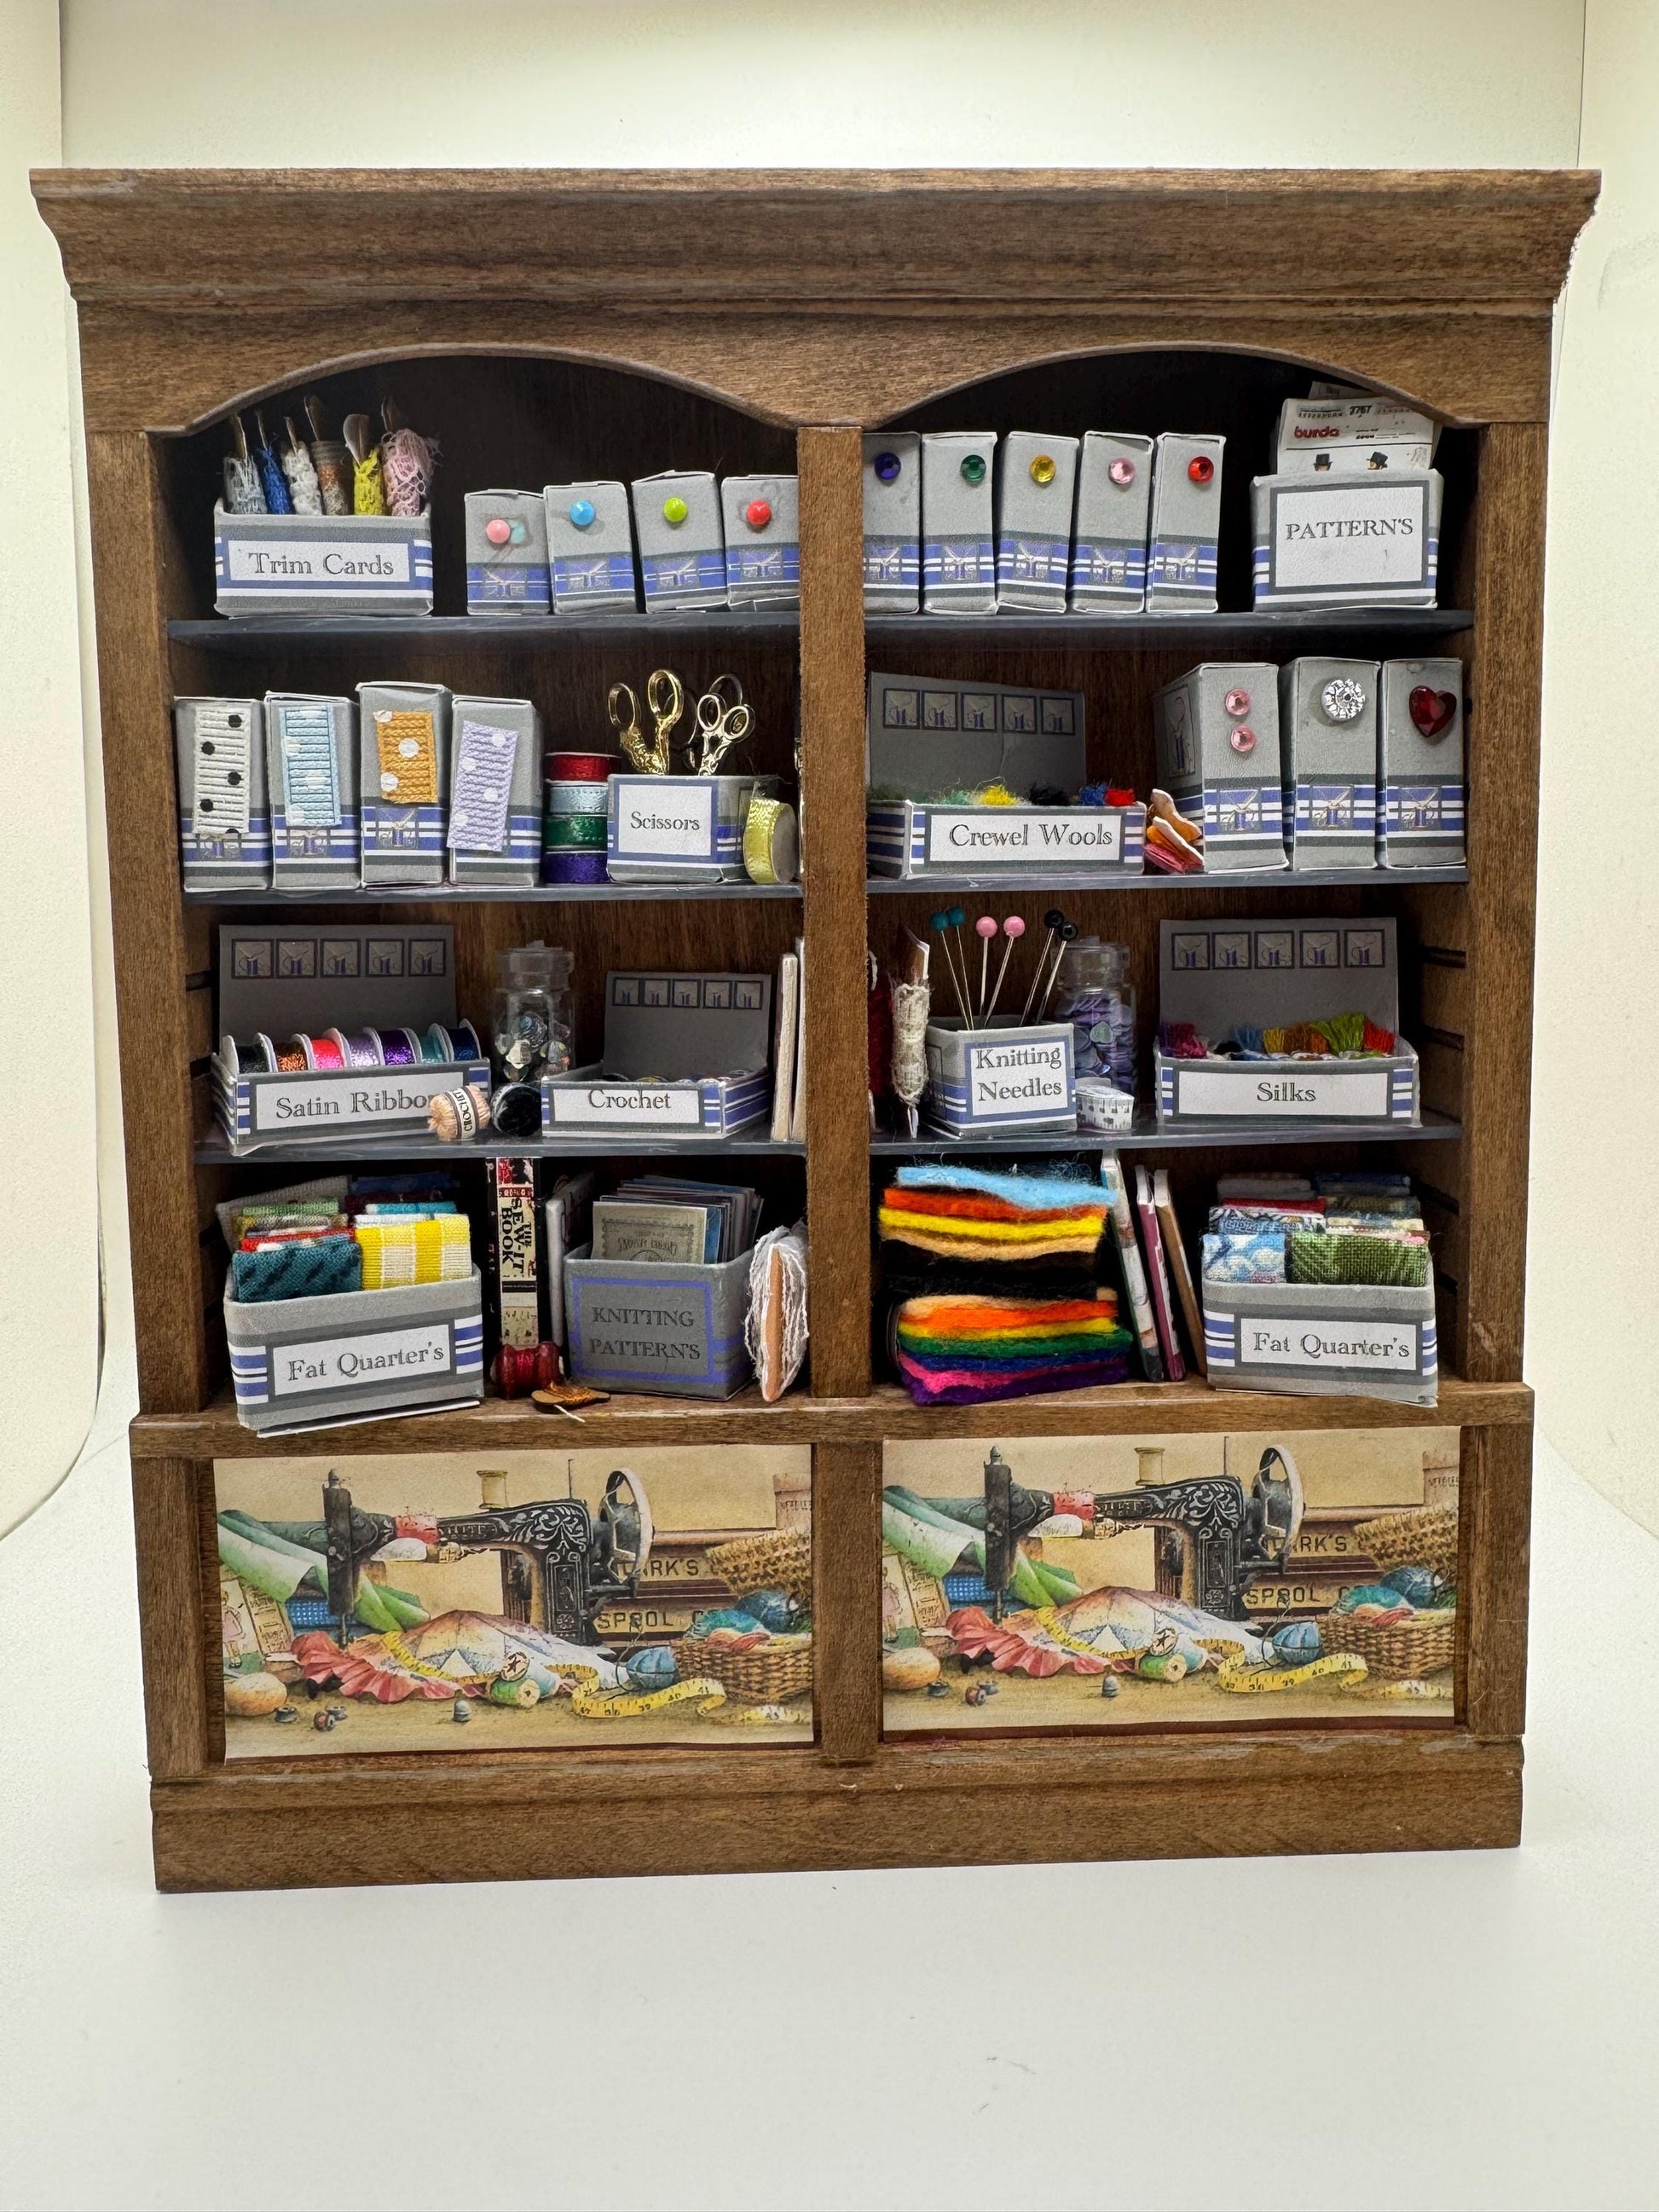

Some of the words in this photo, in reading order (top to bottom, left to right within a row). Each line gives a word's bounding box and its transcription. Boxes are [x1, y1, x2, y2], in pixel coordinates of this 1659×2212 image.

[1294, 426, 1340, 439] burda
[1285, 518, 1413, 540] PATTERN'S
[248, 552, 313, 575] Trim
[323, 553, 394, 575] Cards
[630, 811, 700, 830] Scissors
[949, 823, 1029, 846] Crewel
[1039, 823, 1113, 846] Wools
[975, 1048, 1062, 1070] Knitting
[588, 1089, 672, 1110] Crochet
[978, 1077, 1062, 1102] Needles
[1257, 1082, 1316, 1102] Silks
[275, 1097, 340, 1119] Satin
[501, 1207, 514, 1264] BOOK
[512, 1197, 525, 1273] SEW-IT
[591, 1307, 695, 1327] KNITTING
[1253, 1331, 1291, 1353] Fat
[1300, 1333, 1410, 1359] Quarter's
[288, 1359, 327, 1381] Fat
[337, 1341, 444, 1378] Quarter's
